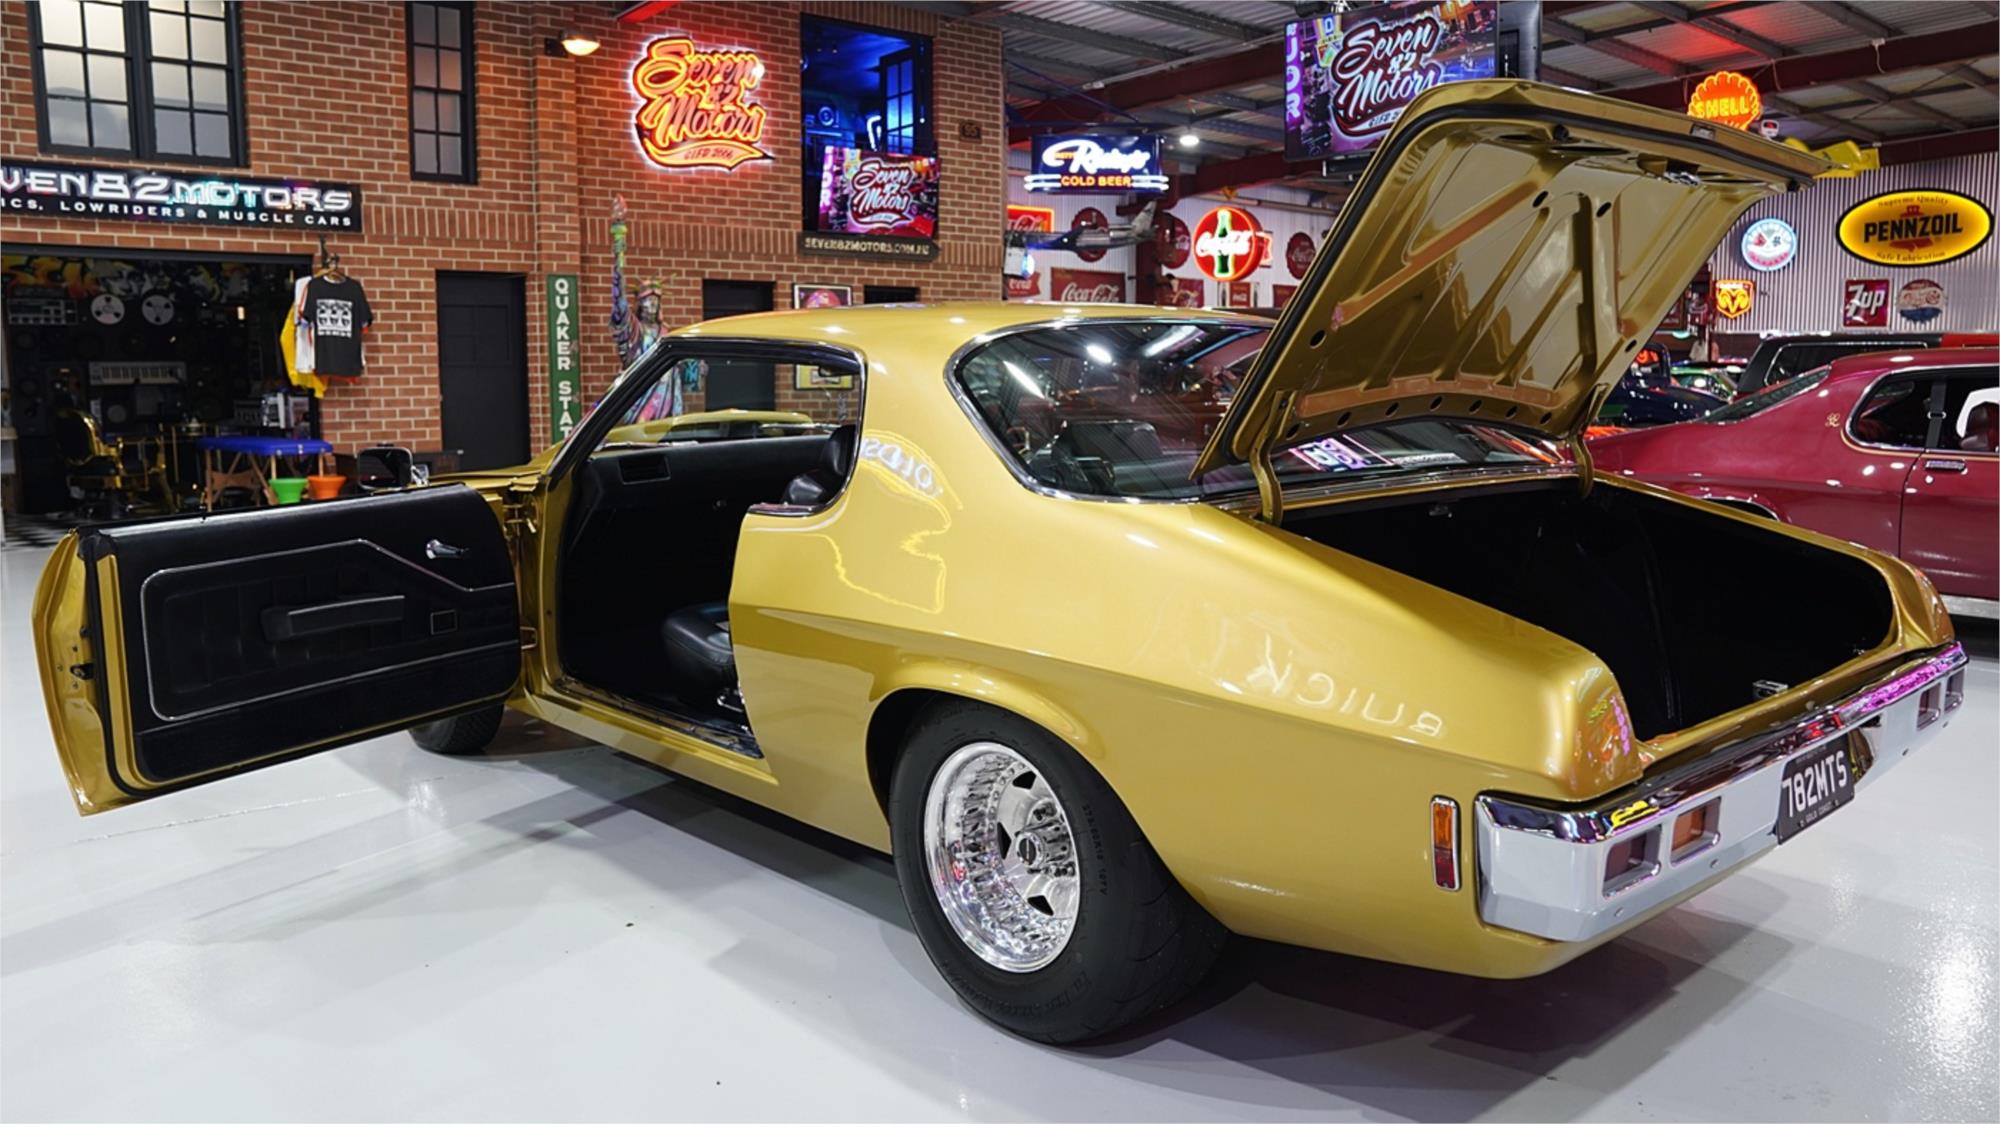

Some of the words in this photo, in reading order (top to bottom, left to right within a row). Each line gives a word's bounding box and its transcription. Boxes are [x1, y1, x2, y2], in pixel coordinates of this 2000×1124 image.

[1336, 24, 1433, 80] Seven
[1388, 54, 1418, 75] 82
[638, 39, 764, 98] Seven
[708, 82, 740, 106] 82
[1338, 66, 1434, 120] Motors
[1695, 96, 1750, 119] SHELL
[642, 94, 766, 147] Motors
[853, 162, 910, 189] Seven
[1061, 175, 1096, 187] COLD
[1098, 175, 1131, 187] BEER
[60, 201, 186, 218] LOWRIDERS
[197, 208, 208, 219] &
[218, 210, 295, 224] MUSCLE
[304, 215, 352, 227] CARS
[1863, 212, 1963, 243] PENNZOIL
[554, 277, 571, 371] QUAKER
[1782, 750, 1847, 818] 782MTS
